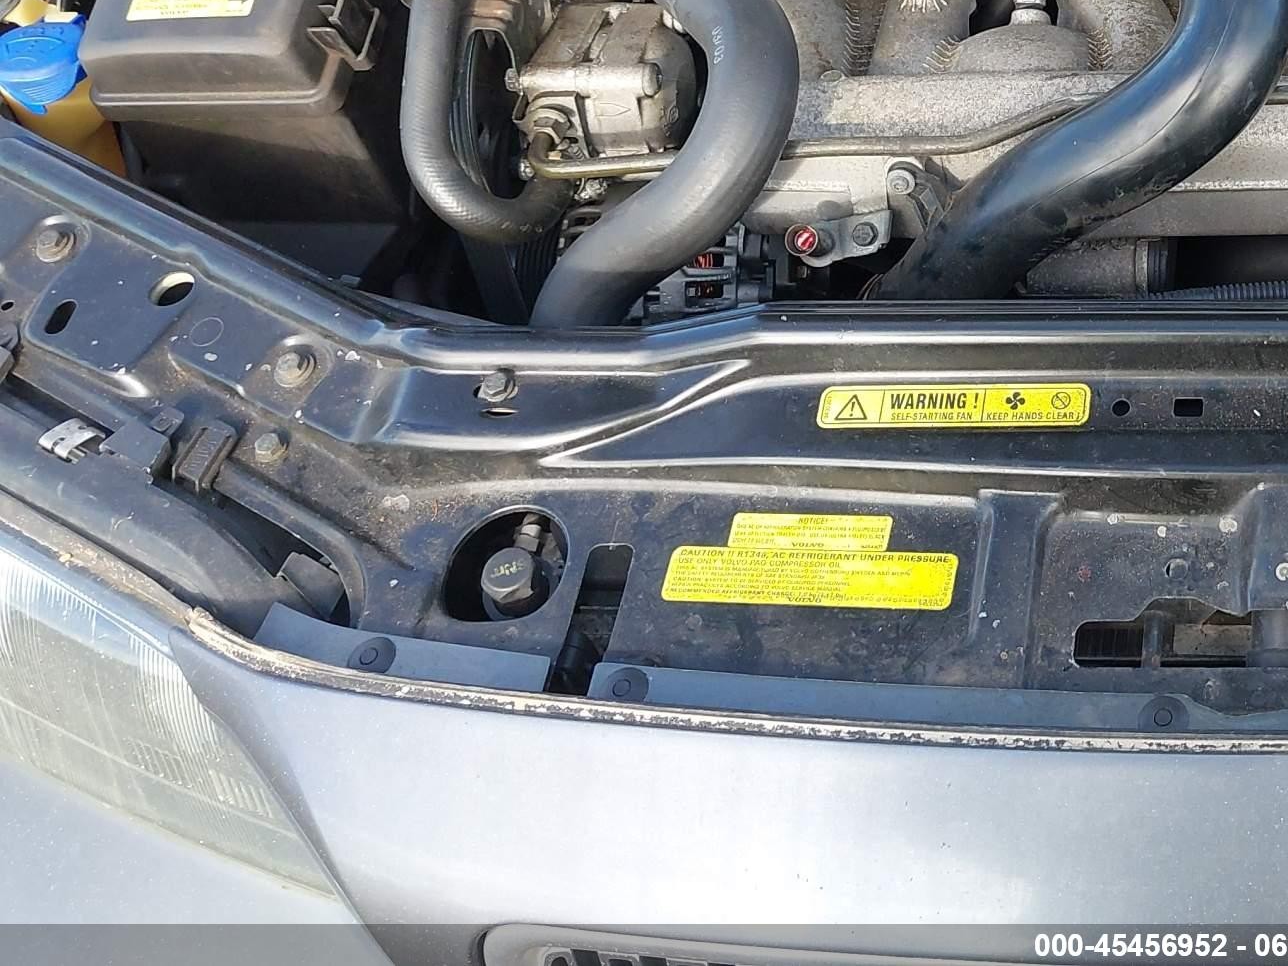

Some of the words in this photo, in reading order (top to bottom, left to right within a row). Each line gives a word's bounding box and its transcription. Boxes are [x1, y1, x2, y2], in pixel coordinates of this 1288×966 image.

[890, 393, 967, 410] WARNING
[973, 393, 979, 409] !
[890, 412, 954, 421] SELF-STARTING
[956, 412, 973, 420] FAN
[986, 412, 1009, 421] KEEP
[1012, 412, 1043, 421] HANDS
[1045, 411, 1075, 420] CLEAR
[680, 548, 725, 557] CAUTION
[771, 551, 786, 560] AC
[788, 552, 858, 562] REFRIGERANT
[860, 553, 895, 563] UNDER
[898, 554, 951, 564] PRESSURE
[697, 557, 717, 565] ONLY
[721, 558, 745, 566] VOLVO
[769, 560, 826, 568] COMPRESSOR
[828, 561, 840, 569] OIL
